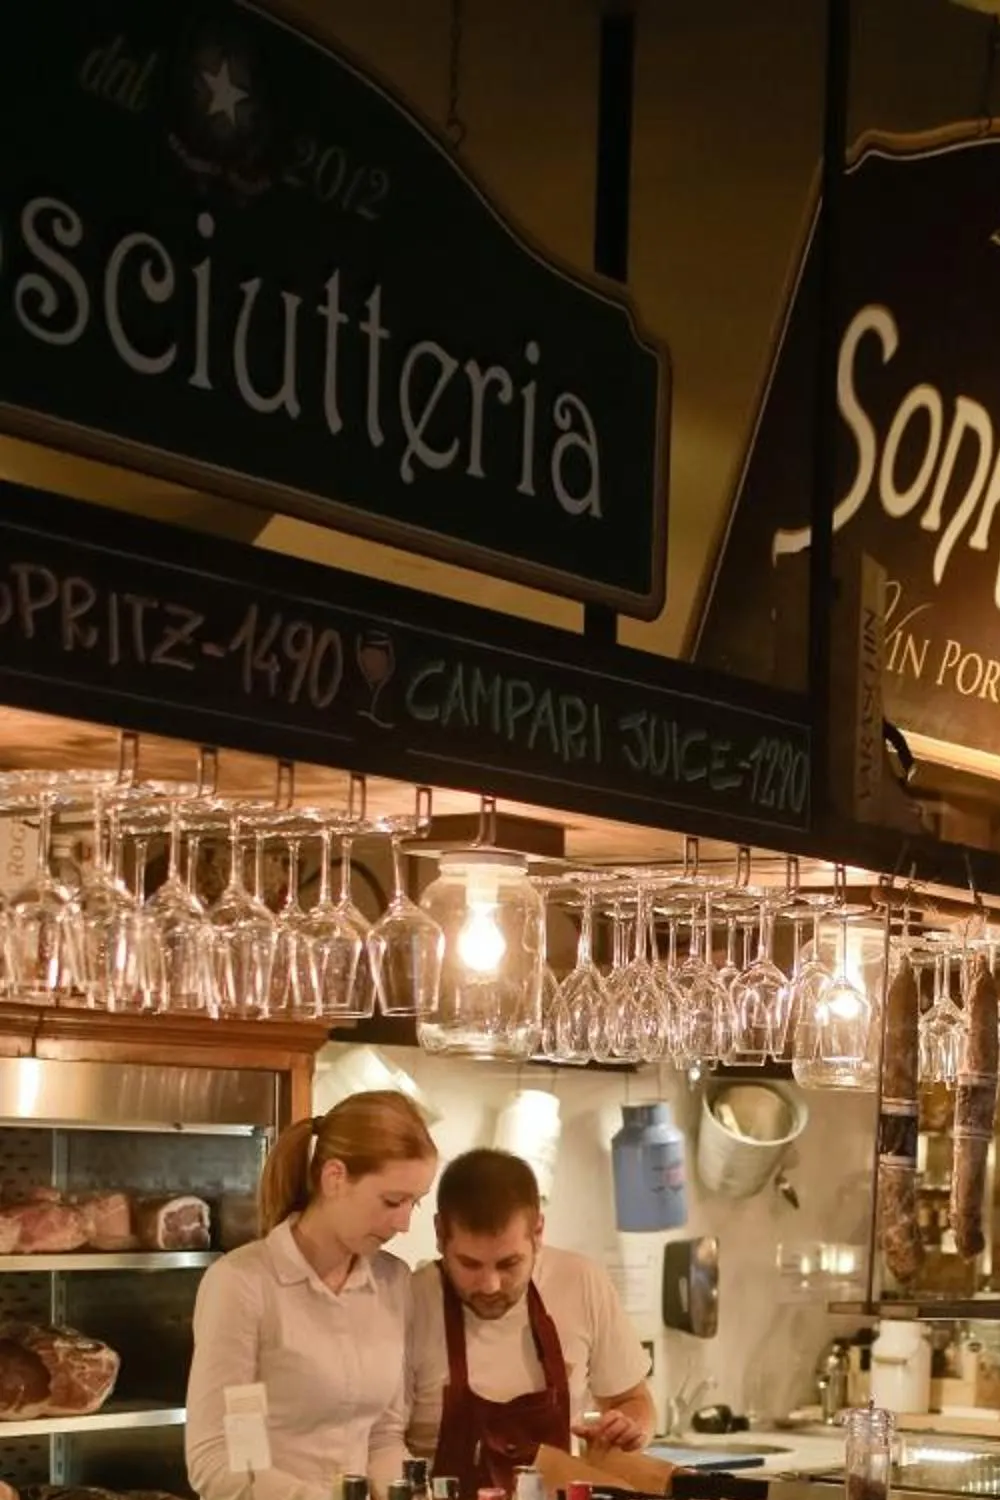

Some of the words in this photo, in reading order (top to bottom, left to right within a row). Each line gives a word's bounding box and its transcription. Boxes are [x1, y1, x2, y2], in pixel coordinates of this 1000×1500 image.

[283, 134, 391, 222] 2012
[0, 196, 603, 518] sciutteria
[405, 660, 602, 765] CAMPARI
